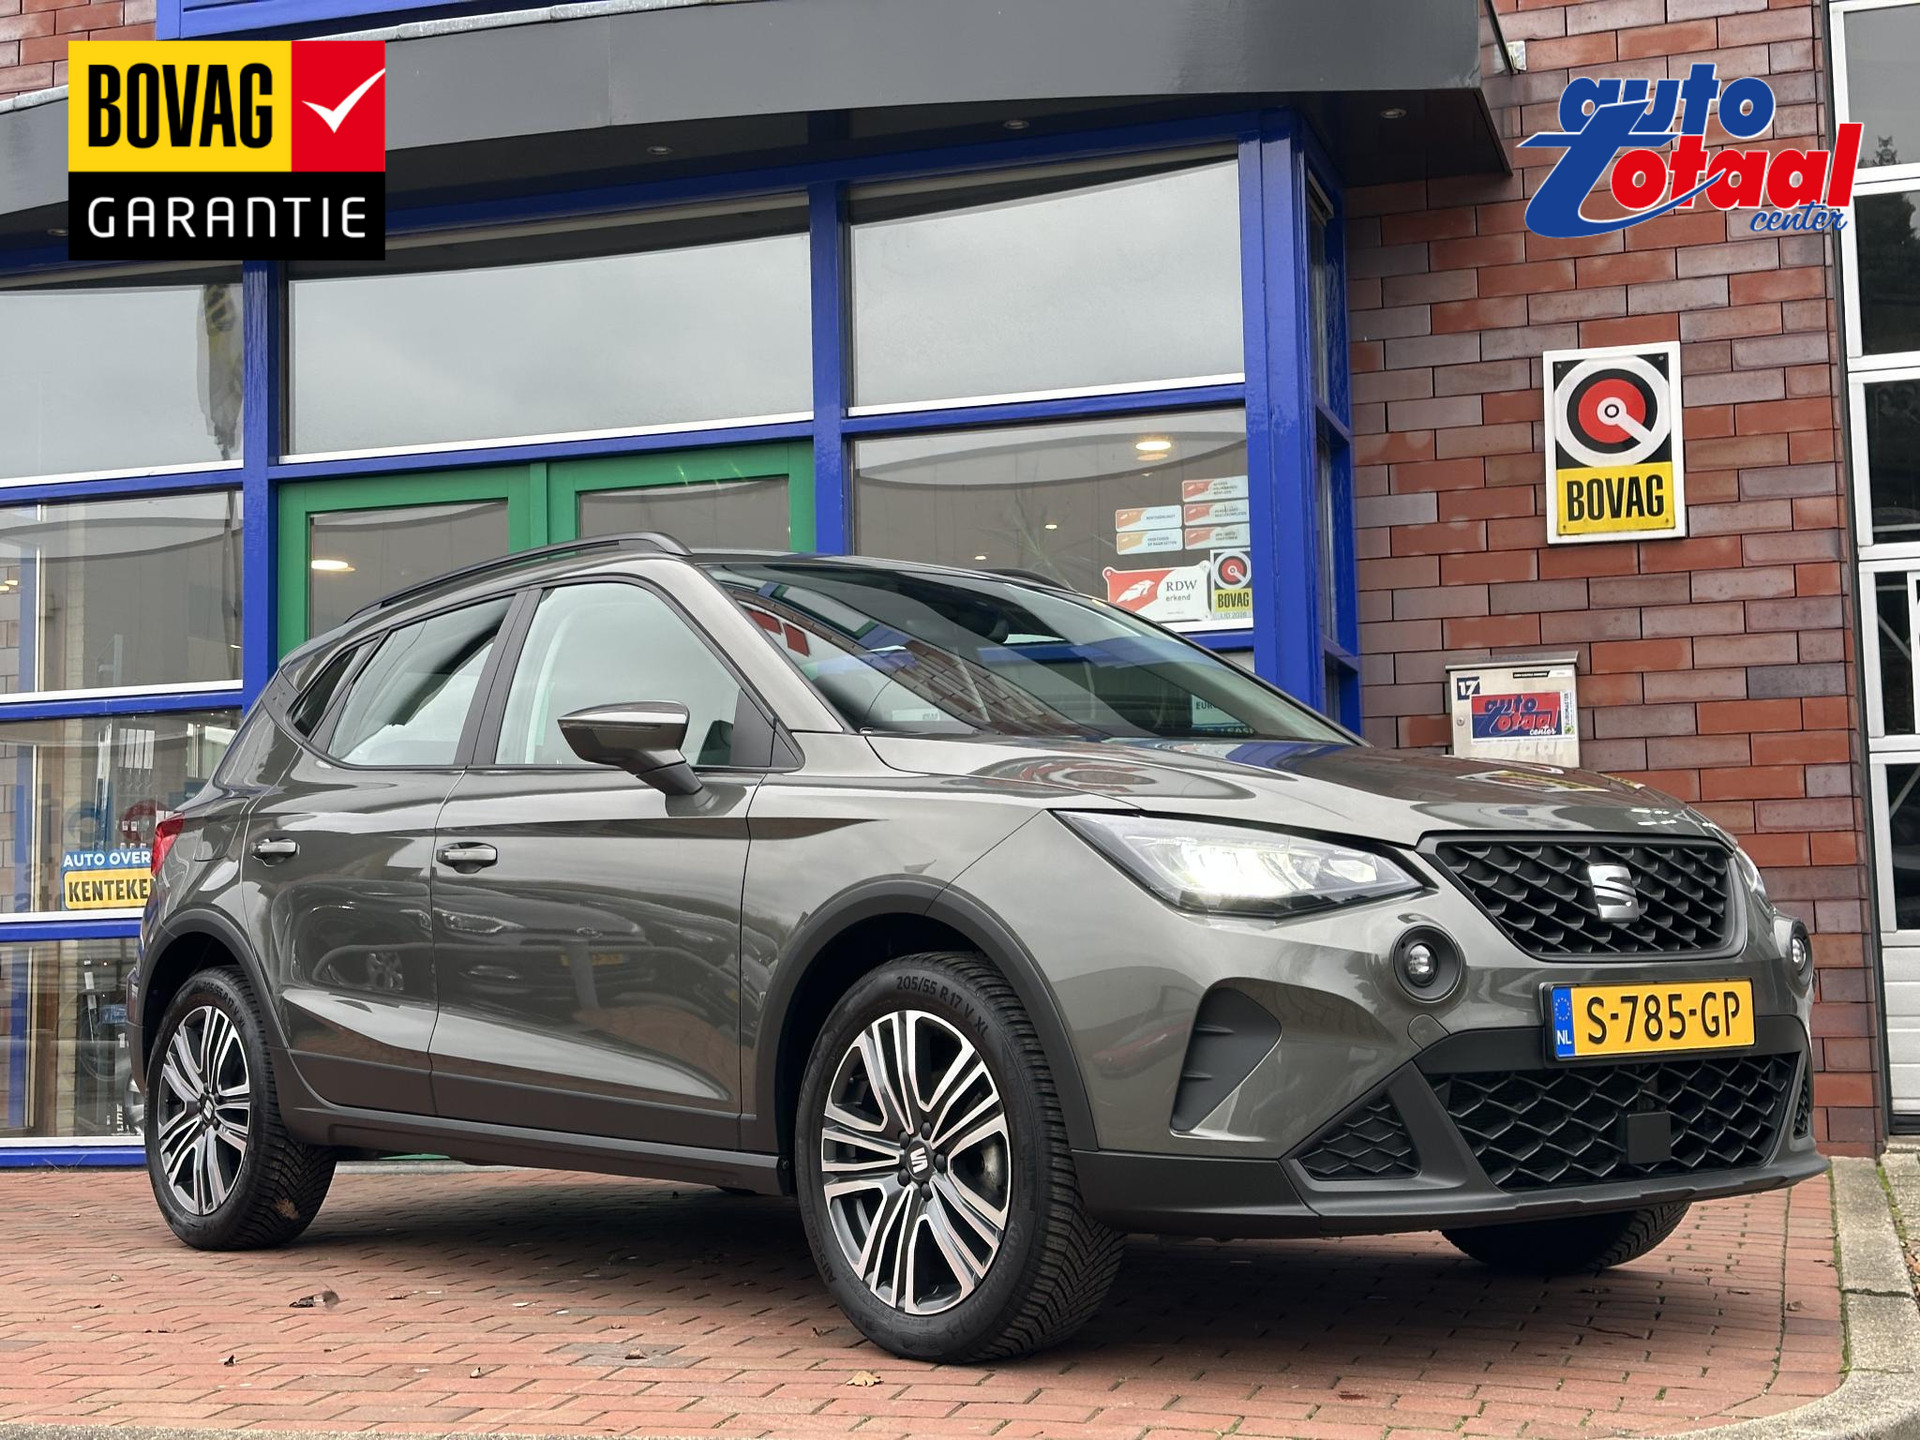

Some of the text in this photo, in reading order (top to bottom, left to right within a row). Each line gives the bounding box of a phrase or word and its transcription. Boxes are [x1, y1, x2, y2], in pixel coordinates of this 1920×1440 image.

[1566, 474, 1664, 522] BOVAG
[1165, 579, 1198, 592] RDW
[1165, 593, 1191, 603] erkend
[1216, 591, 1250, 609] BOVAG
[1458, 680, 1480, 696] 17
[1485, 694, 1539, 713] auto
[1529, 724, 1557, 736] center
[63, 851, 151, 867] AUTO OVER
[68, 878, 154, 903] KENTEKE
[896, 976, 938, 996] 205/55
[964, 1003, 975, 1019] V
[974, 1016, 989, 1041] XL
[1586, 991, 1740, 1046] S-785-GP
[1556, 1030, 1573, 1046] NL
